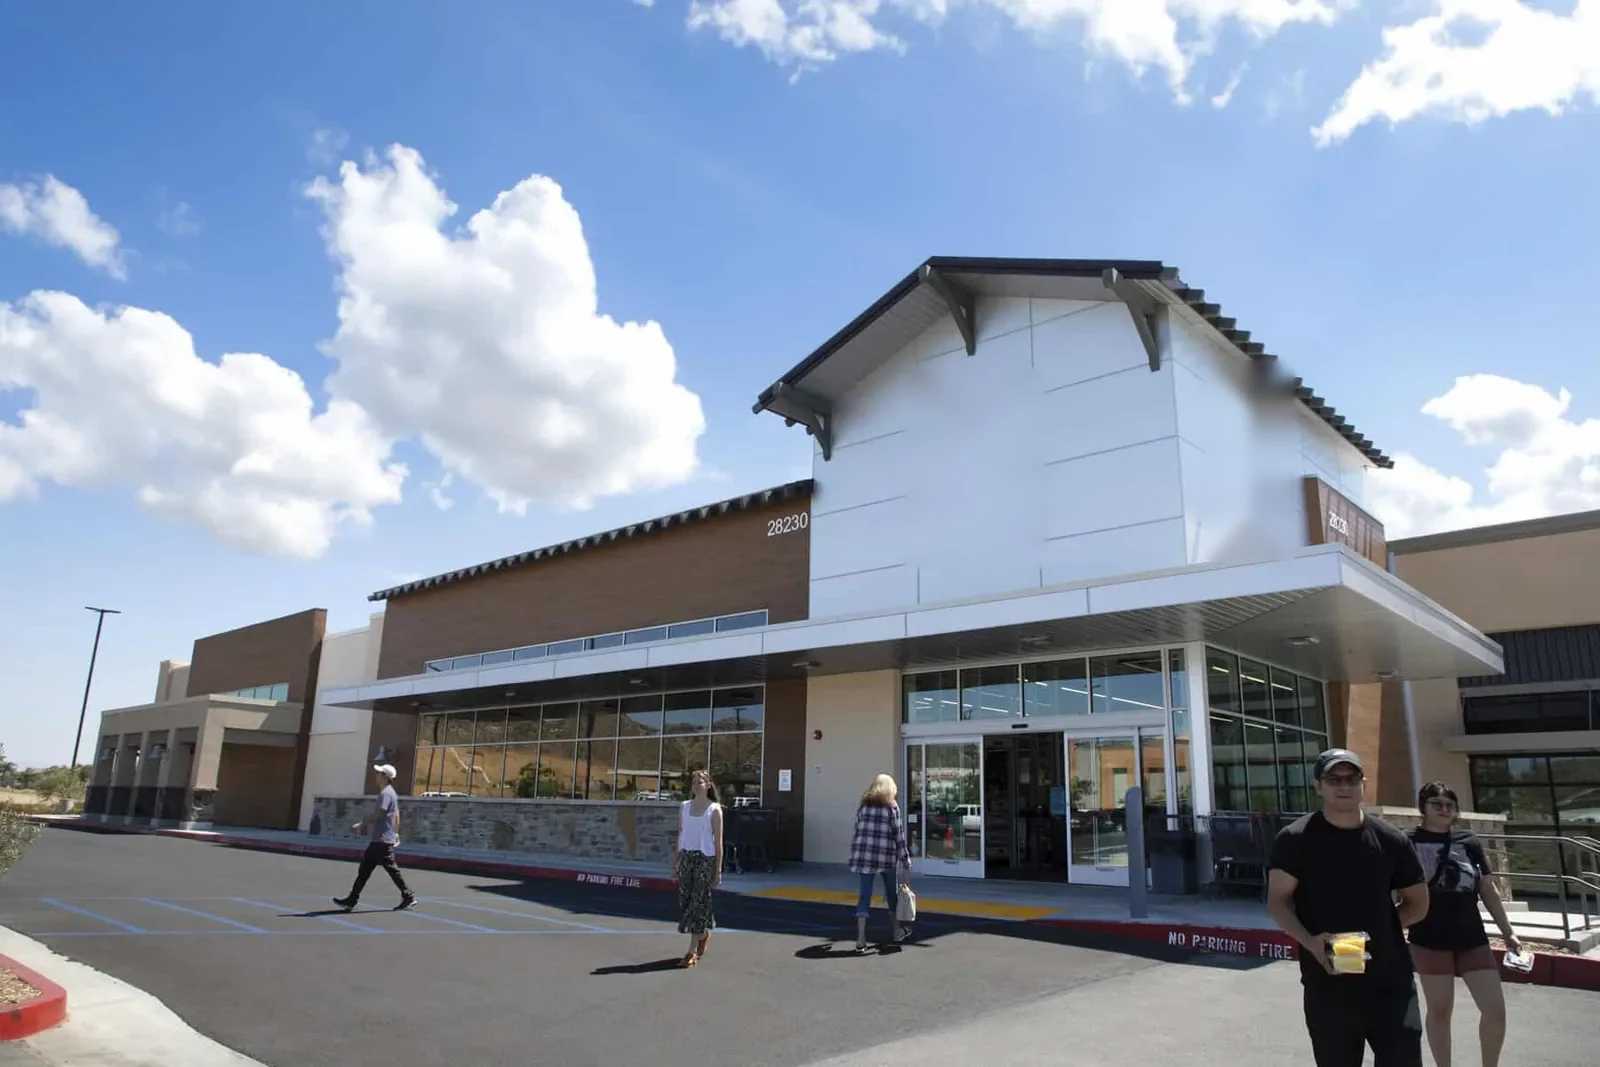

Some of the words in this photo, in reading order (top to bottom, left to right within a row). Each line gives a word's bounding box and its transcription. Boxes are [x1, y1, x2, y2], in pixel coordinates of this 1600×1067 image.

[767, 512, 808, 536] 28230
[609, 876, 624, 886] FIRE
[626, 877, 640, 888] LANE
[1168, 931, 1186, 946] NO
[1192, 934, 1246, 954] PARKING
[1259, 942, 1293, 960] FIRE
